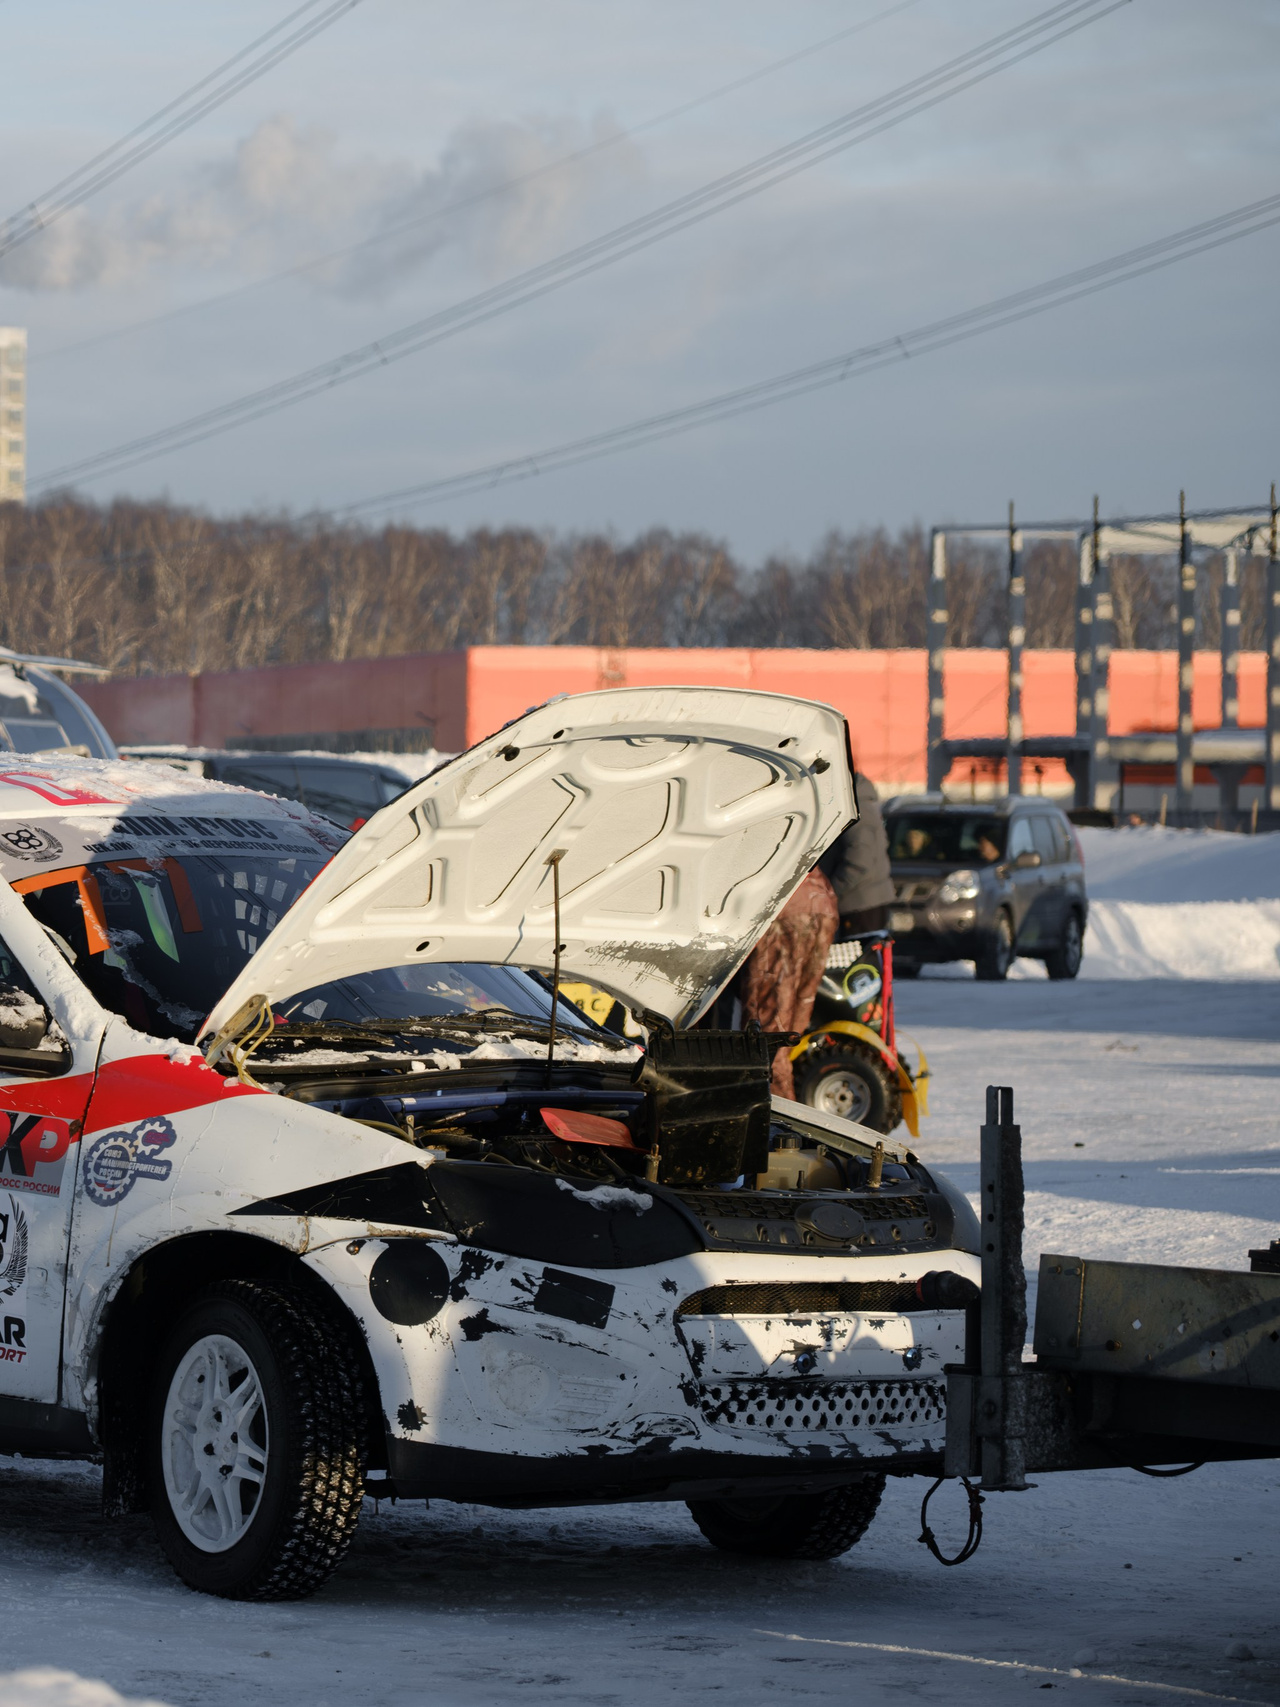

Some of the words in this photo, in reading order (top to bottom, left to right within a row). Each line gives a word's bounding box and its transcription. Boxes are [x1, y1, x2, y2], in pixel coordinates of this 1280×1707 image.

[273, 843, 321, 856] РОССИИ
[104, 1148, 122, 1158] СОЮЗ
[100, 1157, 167, 1175] МАШИНОСТРОИТЕЛЕЙ
[100, 1167, 123, 1178] РОССИИ
[23, 1181, 60, 1195] РОССИИ
